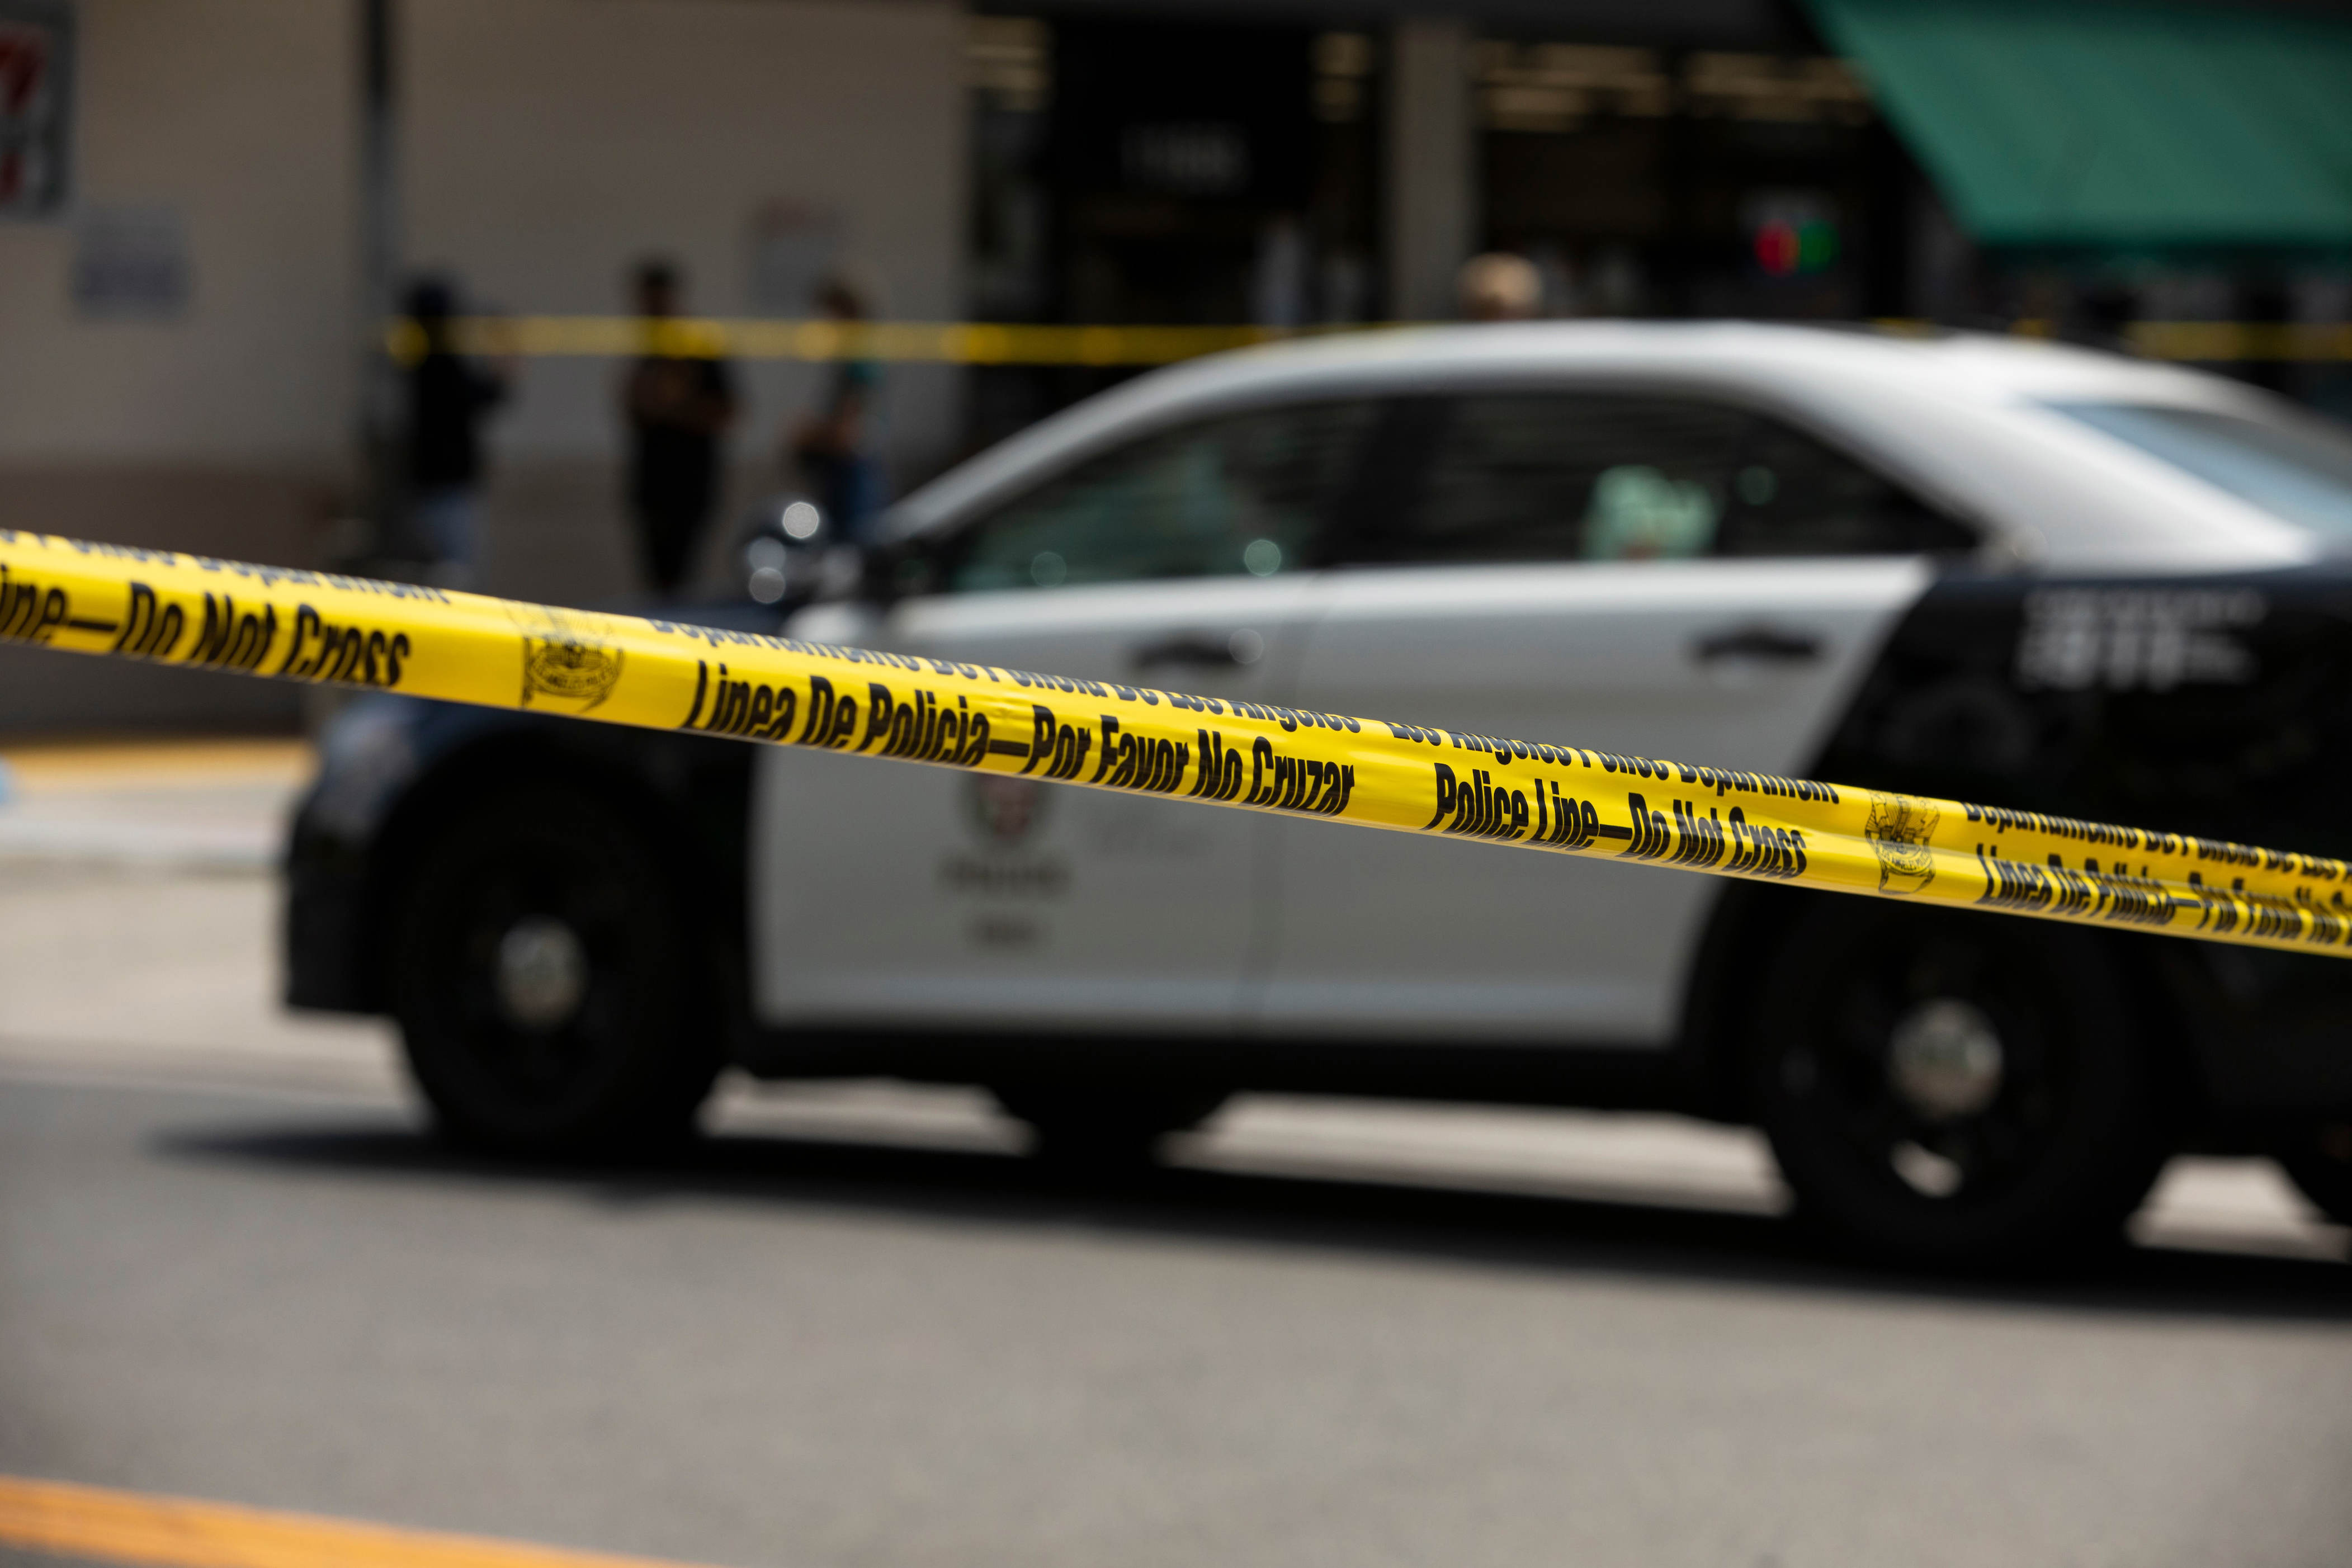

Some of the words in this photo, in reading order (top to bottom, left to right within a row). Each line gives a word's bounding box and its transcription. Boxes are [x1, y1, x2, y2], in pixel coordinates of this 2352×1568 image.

[190, 591, 278, 669] Not
[280, 602, 412, 687] Cross
[679, 659, 795, 741] Linea
[796, 676, 857, 748] De
[1089, 715, 1189, 793] Favor
[1187, 729, 1243, 801] No
[1240, 736, 1354, 817] Cruzar
[1447, 730, 1572, 766] Angeles
[1673, 761, 1839, 805] Department
[1420, 763, 1529, 841] Police
[1665, 799, 1726, 867] Not
[1721, 806, 1807, 879] Cross
